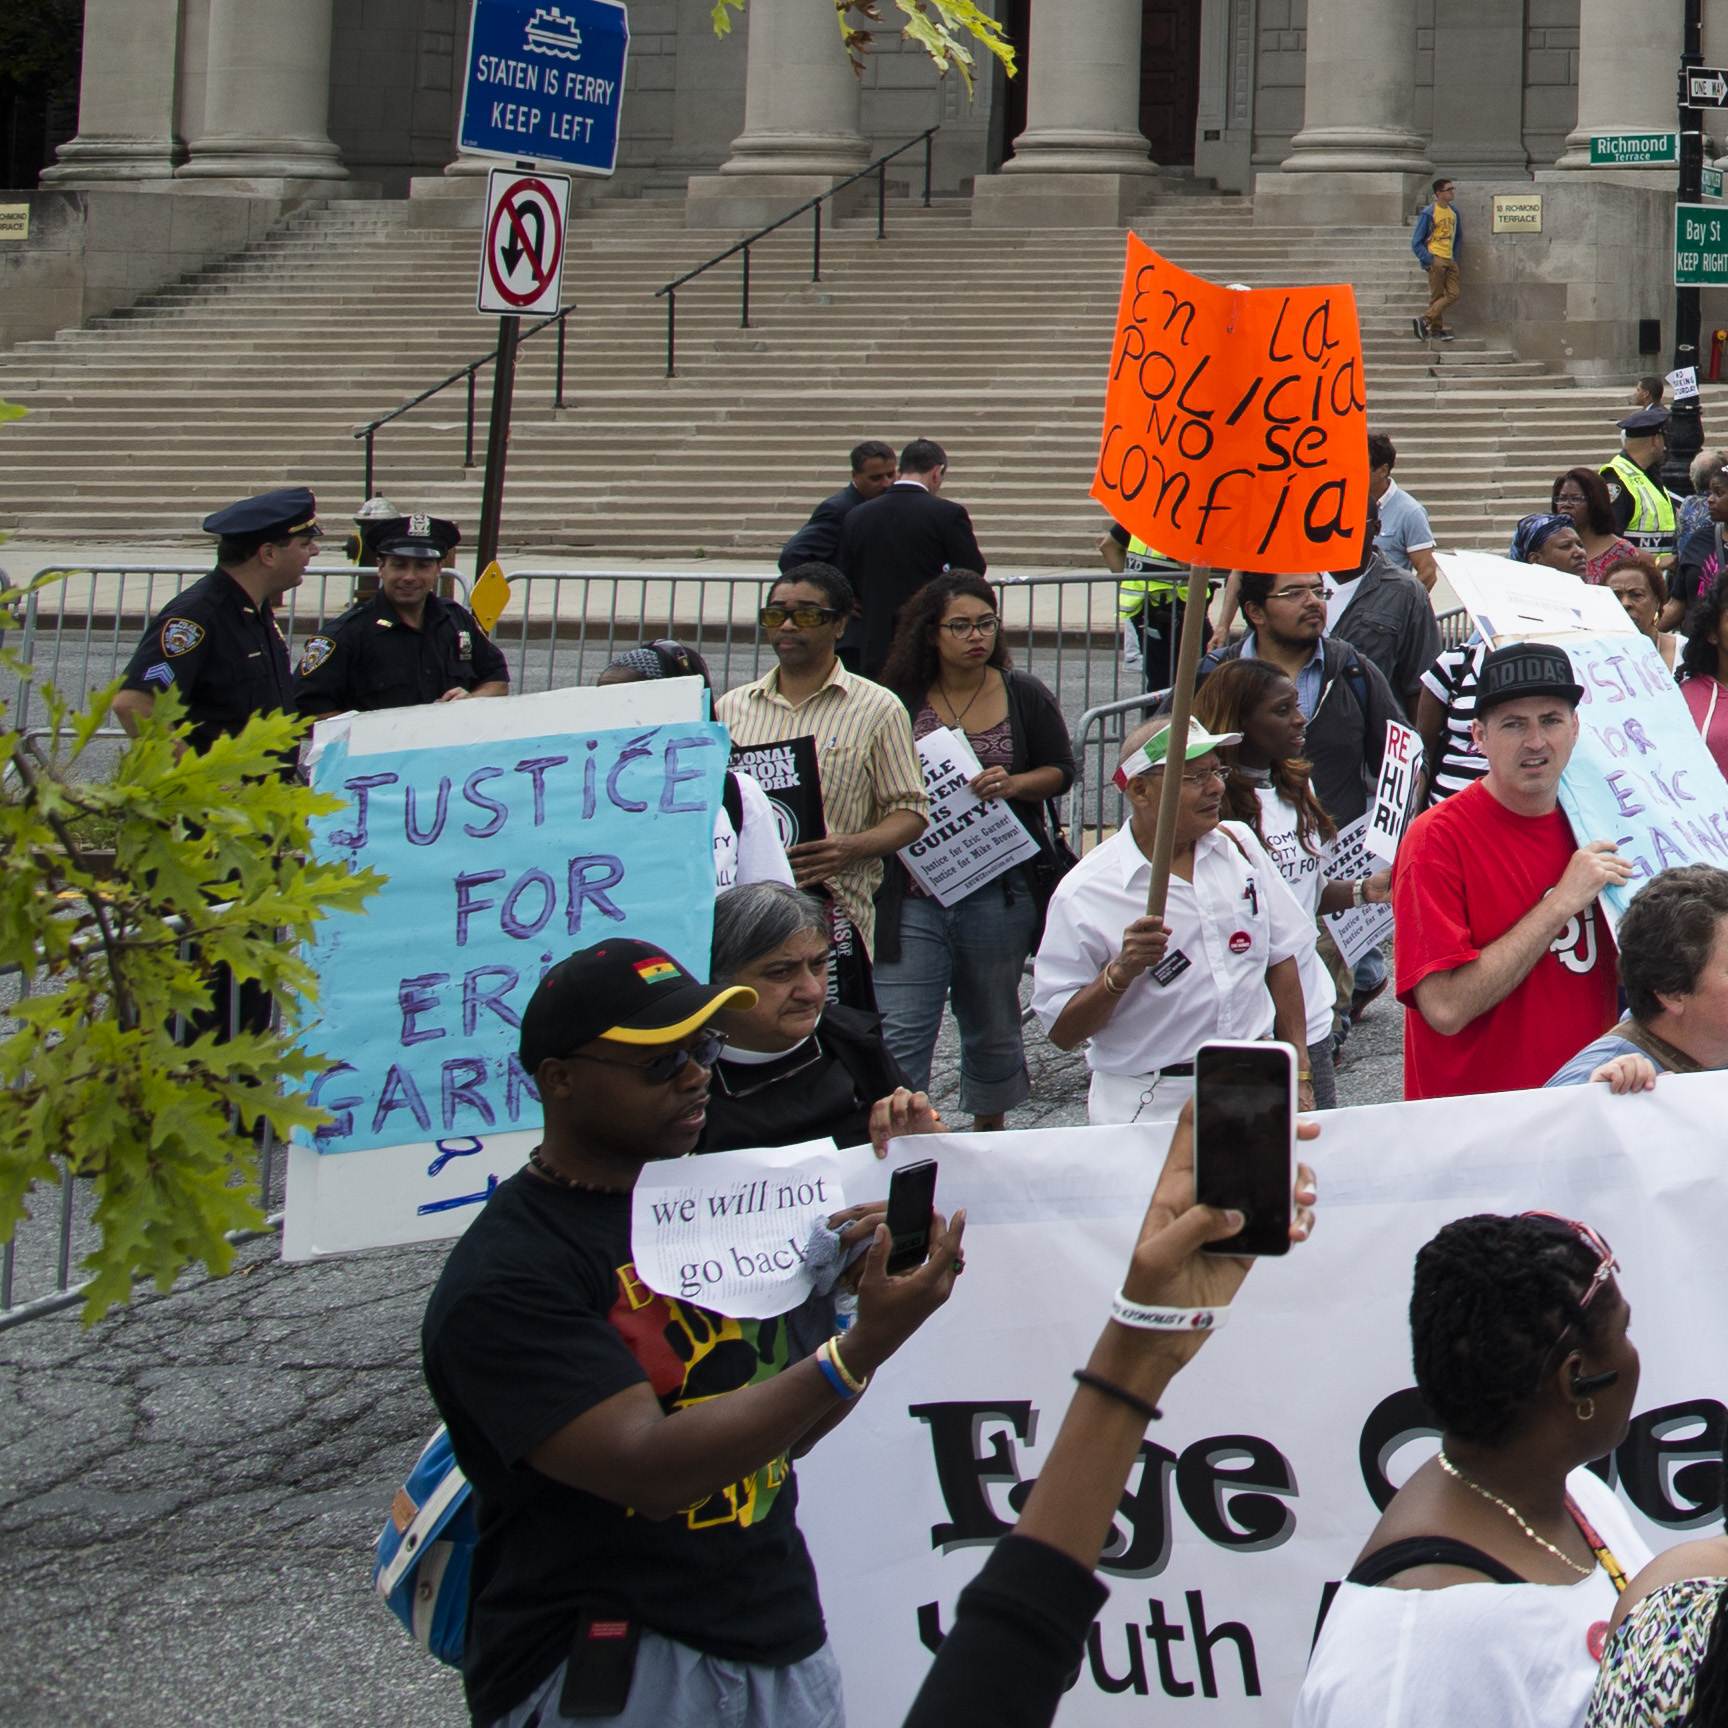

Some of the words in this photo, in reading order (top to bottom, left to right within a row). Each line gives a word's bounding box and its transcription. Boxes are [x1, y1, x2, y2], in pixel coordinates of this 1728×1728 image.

[477, 55, 538, 91] STATEN
[544, 68, 559, 95] IS
[565, 73, 614, 105] FERRY
[1694, 81, 1706, 95] ONE
[1712, 82, 1724, 96] WAY
[491, 102, 540, 134] KEEP
[550, 112, 594, 144] LEFT
[1598, 136, 1667, 154] Richmond
[1615, 153, 1650, 161] Terrace
[1498, 215, 1537, 223] TERRACE
[1505, 204, 1539, 212] RICHMOND
[1686, 220, 1706, 246] Bay
[1710, 221, 1721, 241] St
[1678, 252, 1698, 272] KEEP
[1703, 253, 1728, 272] RIGHT
[1133, 265, 1196, 346] En
[1147, 403, 1213, 460] NO
[1490, 657, 1566, 686] ADIDAS
[908, 799, 999, 858] GUILTY!
[454, 854, 626, 946] FOR
[652, 1199, 695, 1225] we
[708, 1181, 768, 1218] will
[777, 1177, 827, 1209] not
[680, 1260, 722, 1297] go
[729, 1239, 807, 1276] back
